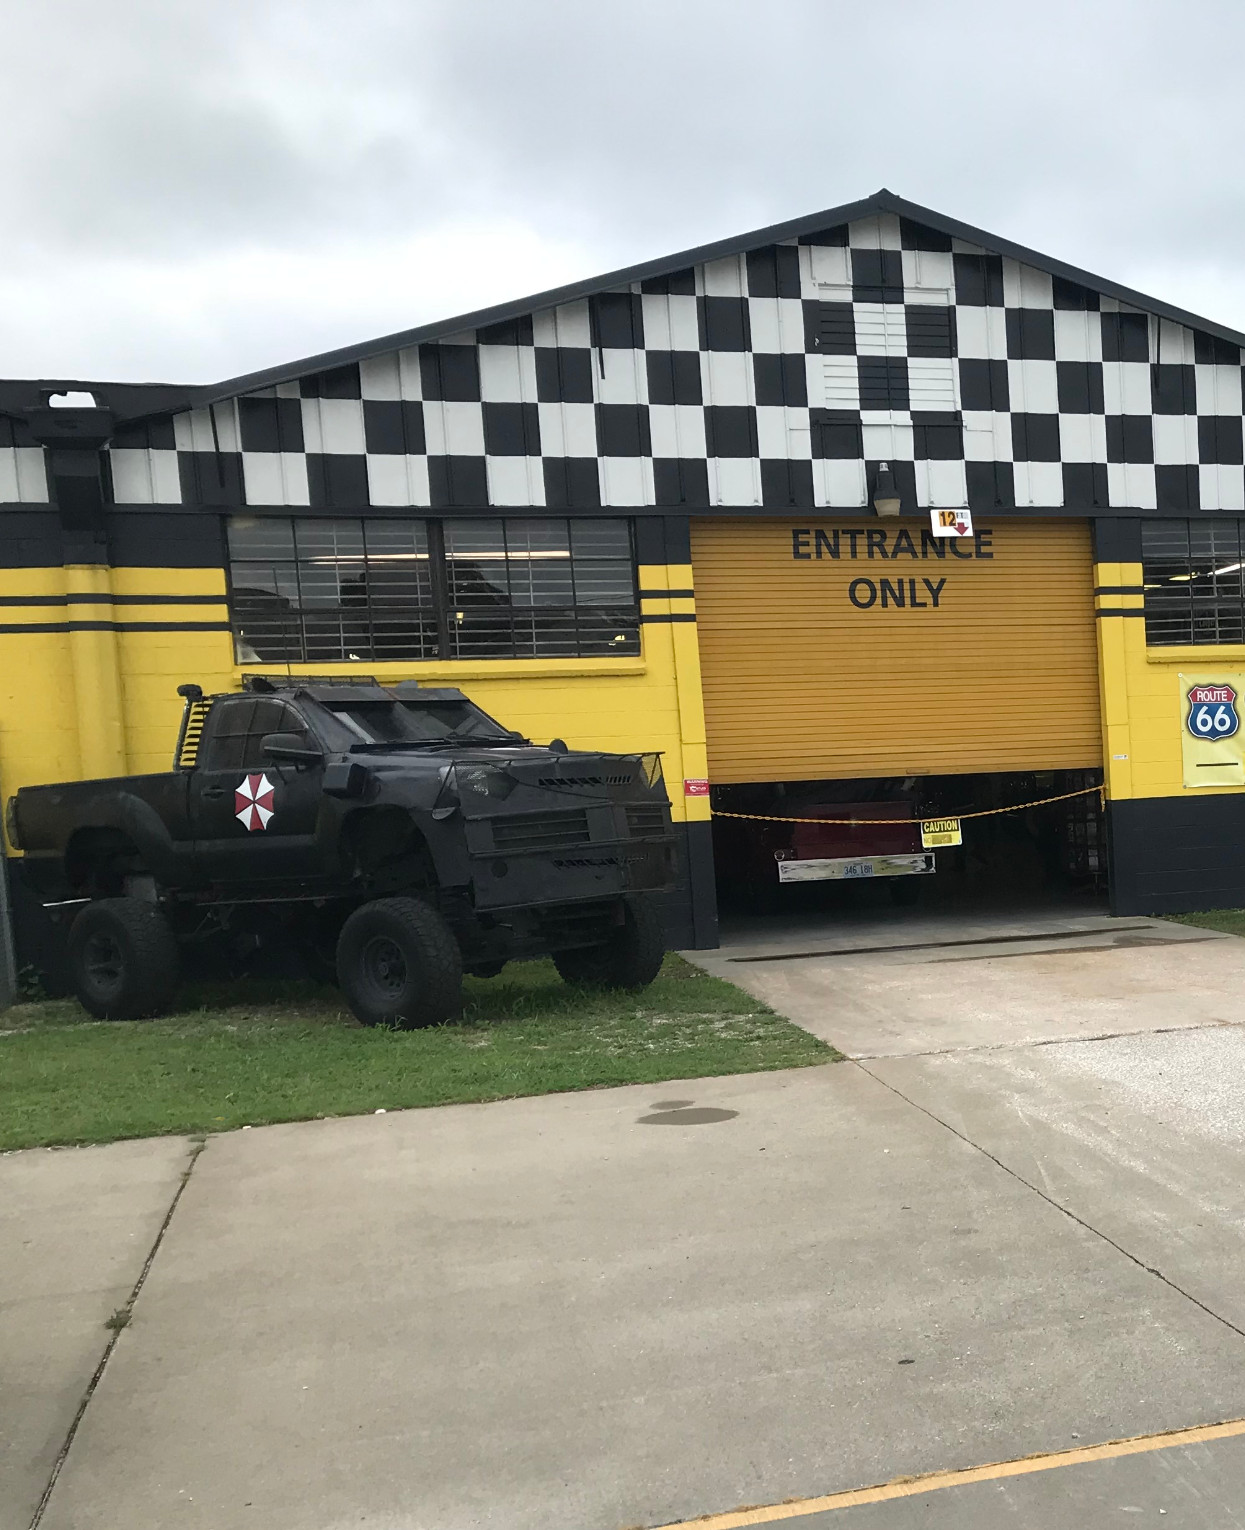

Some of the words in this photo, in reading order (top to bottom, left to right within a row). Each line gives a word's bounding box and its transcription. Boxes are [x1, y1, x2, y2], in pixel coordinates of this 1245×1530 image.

[940, 511, 956, 526] 12
[792, 529, 994, 559] ENTRANCE
[849, 578, 947, 609] ONLY
[1196, 690, 1228, 702] ROUTE
[1195, 705, 1231, 732] 66
[923, 820, 957, 832] CAUTION
[844, 865, 857, 875] 346
